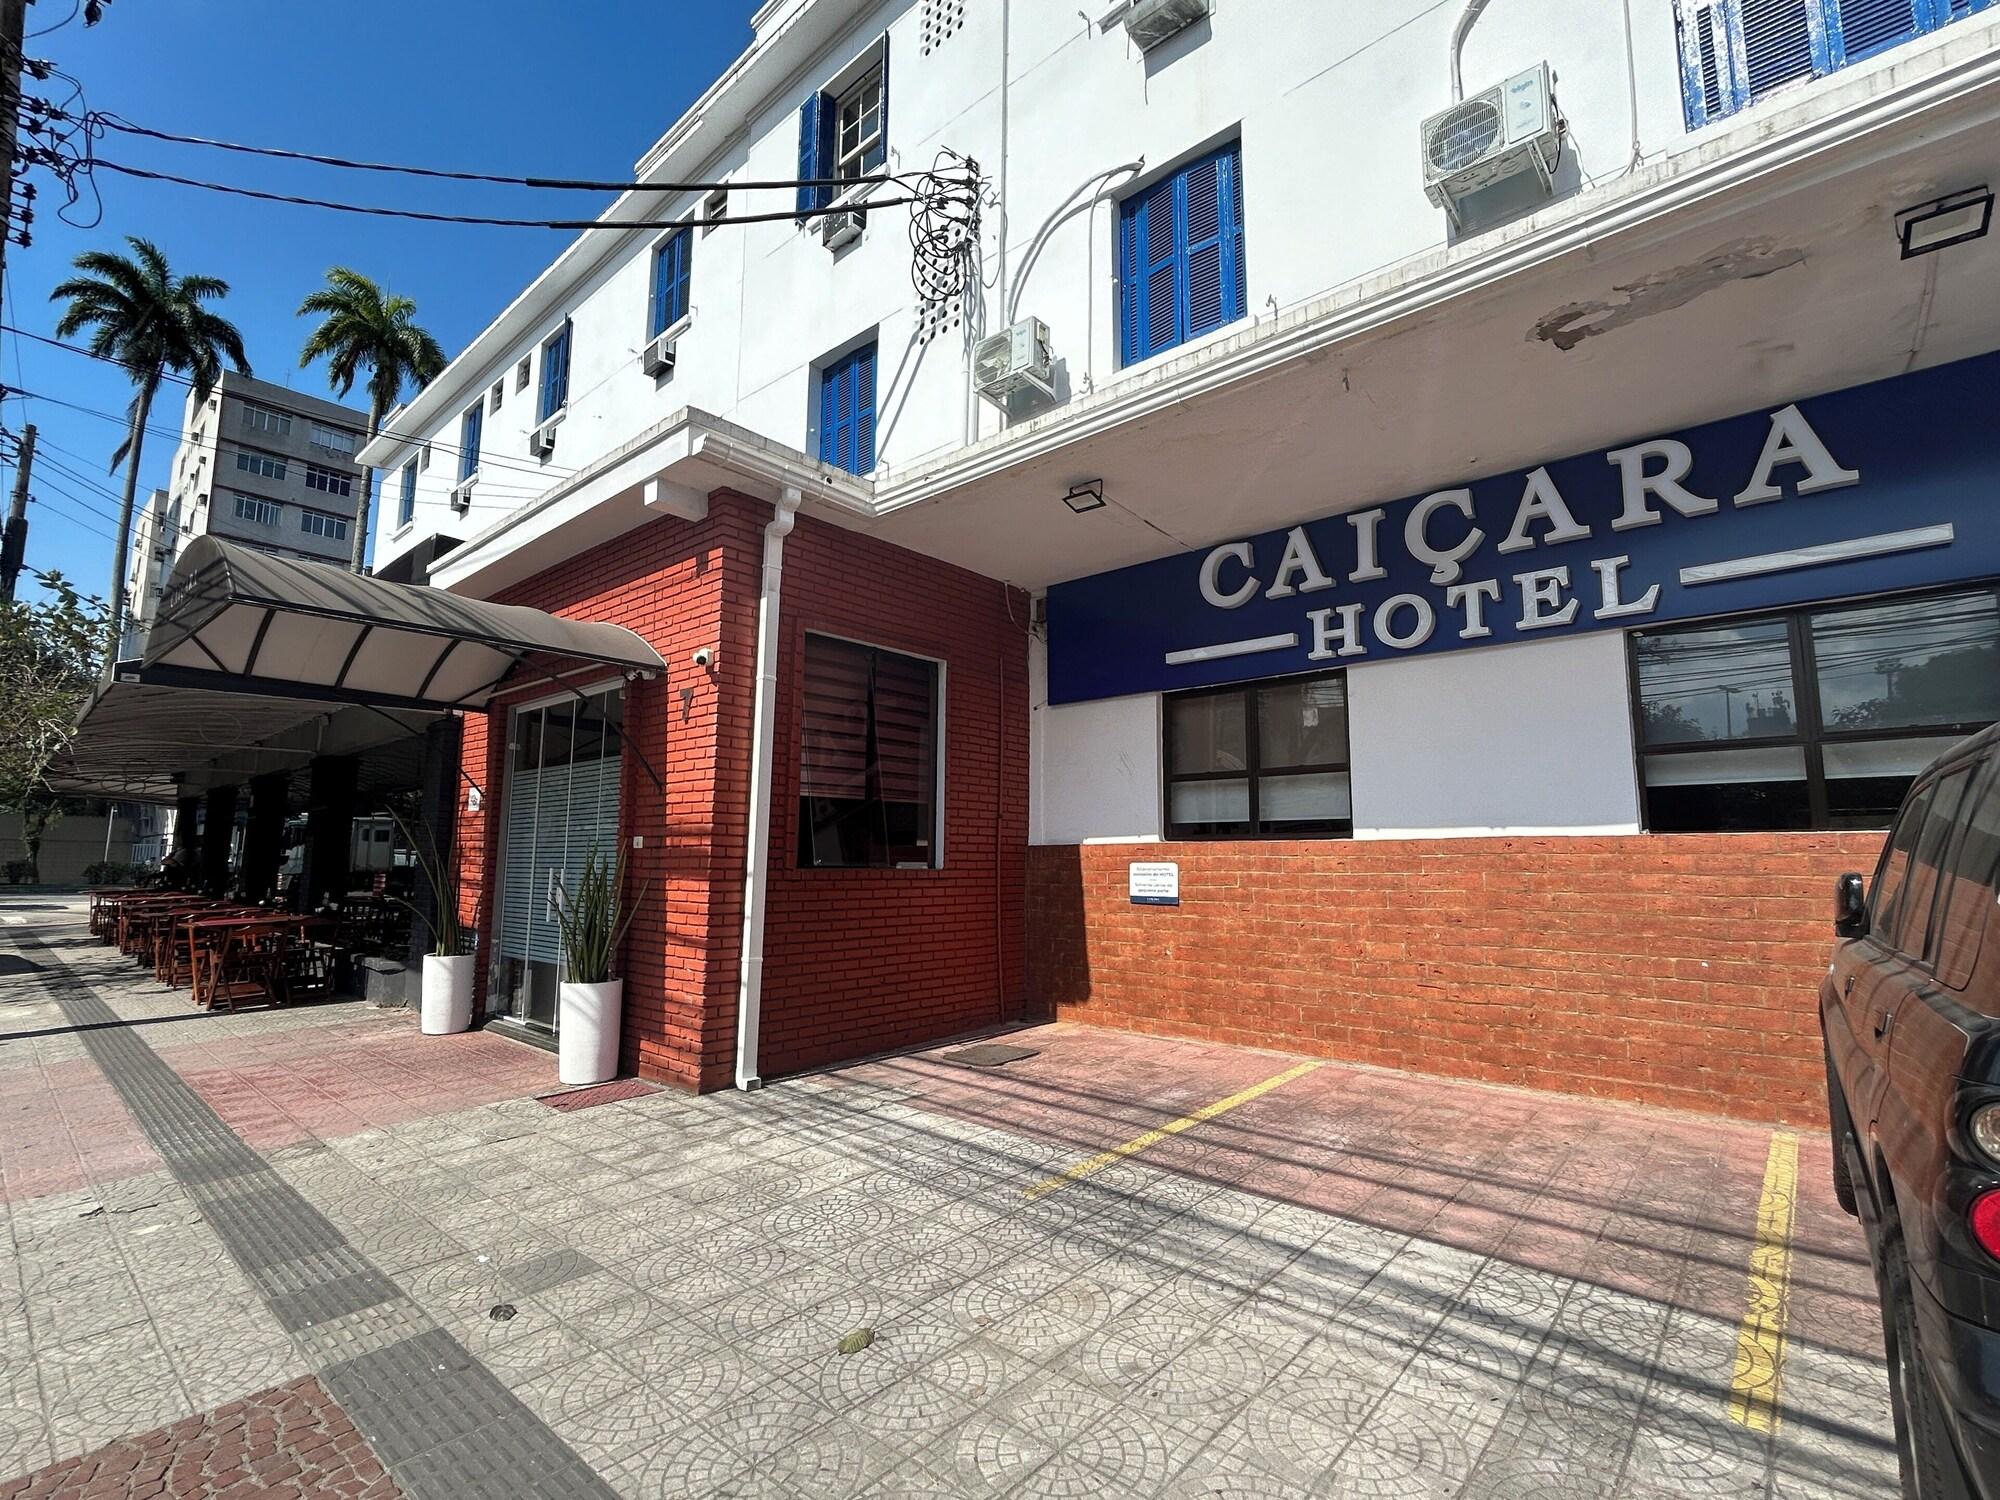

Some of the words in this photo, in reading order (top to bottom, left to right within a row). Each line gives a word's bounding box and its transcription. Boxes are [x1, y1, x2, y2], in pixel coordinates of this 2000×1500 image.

[1199, 404, 1860, 609] CAIÇARA
[1306, 555, 1660, 660] HOTEL
[679, 688, 695, 723] 7
